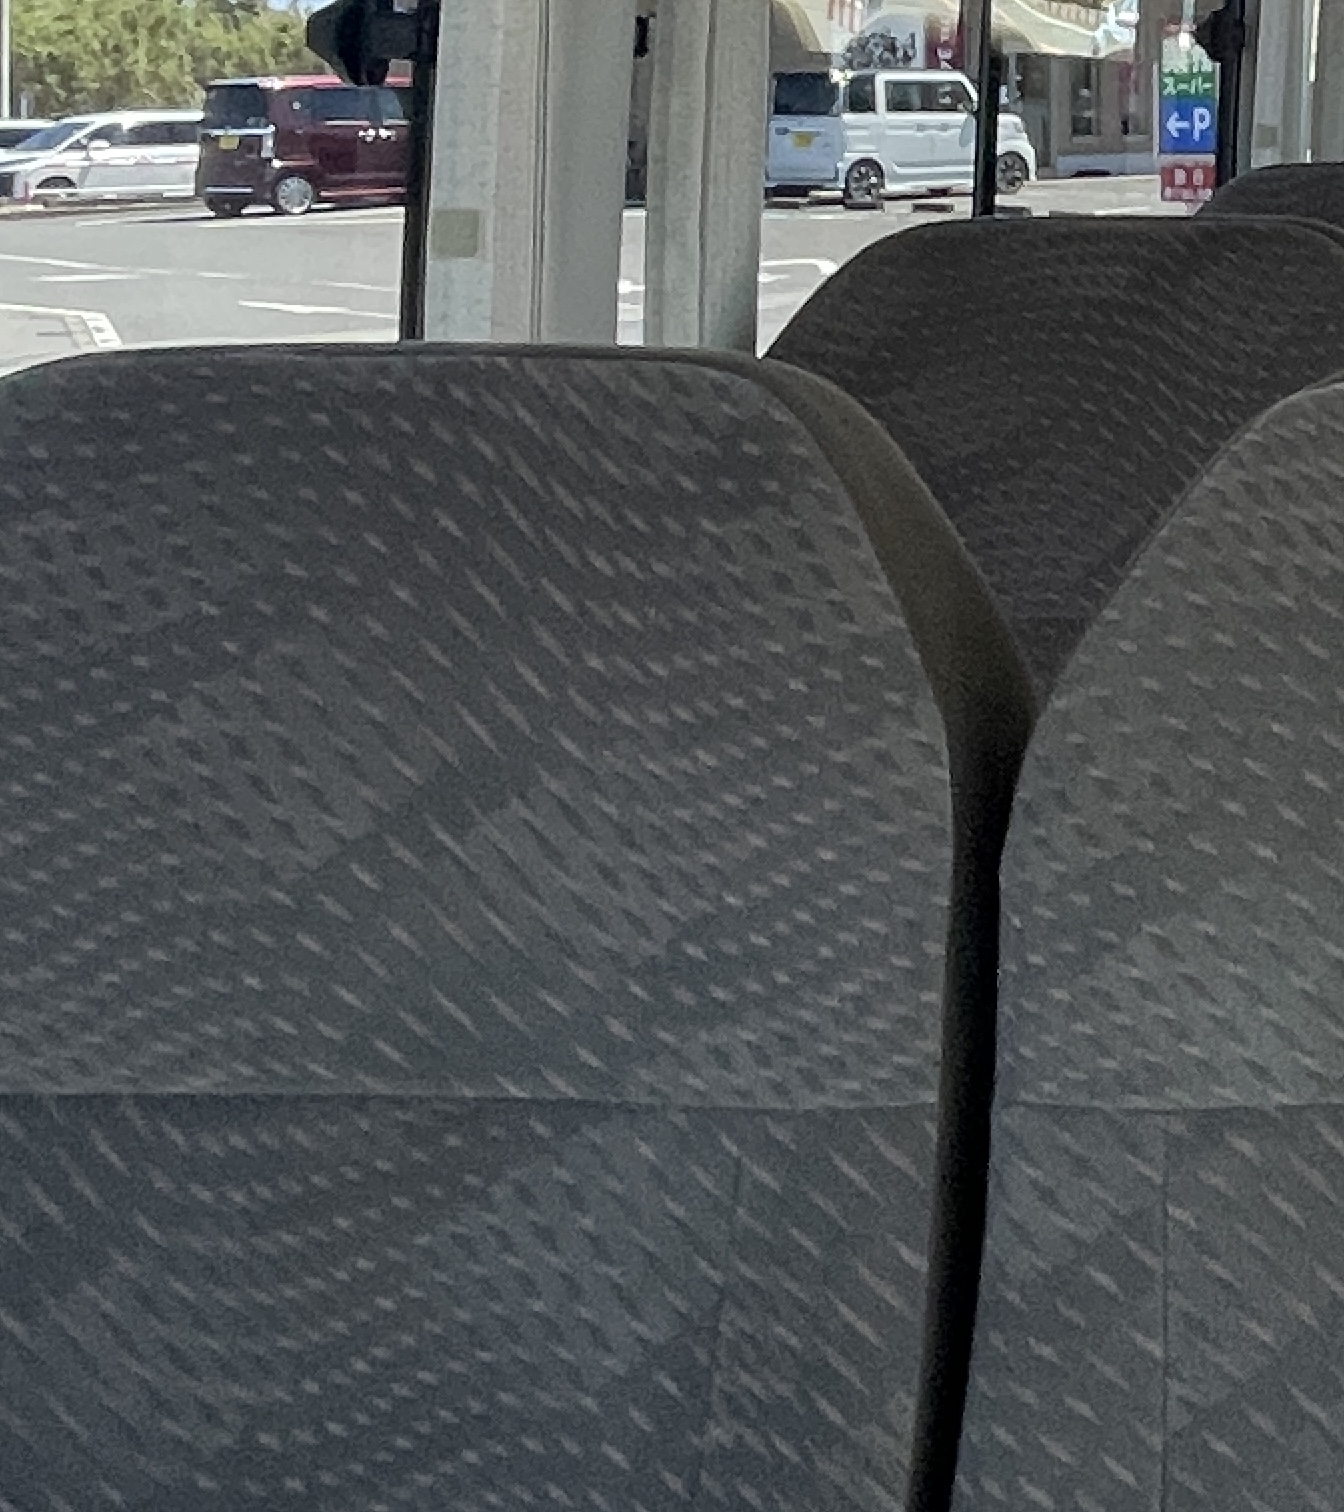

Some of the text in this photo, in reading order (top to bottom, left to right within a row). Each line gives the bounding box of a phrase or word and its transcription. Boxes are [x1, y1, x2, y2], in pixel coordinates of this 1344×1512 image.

[1162, 76, 1214, 96] スーパー
[1192, 106, 1212, 142] P
